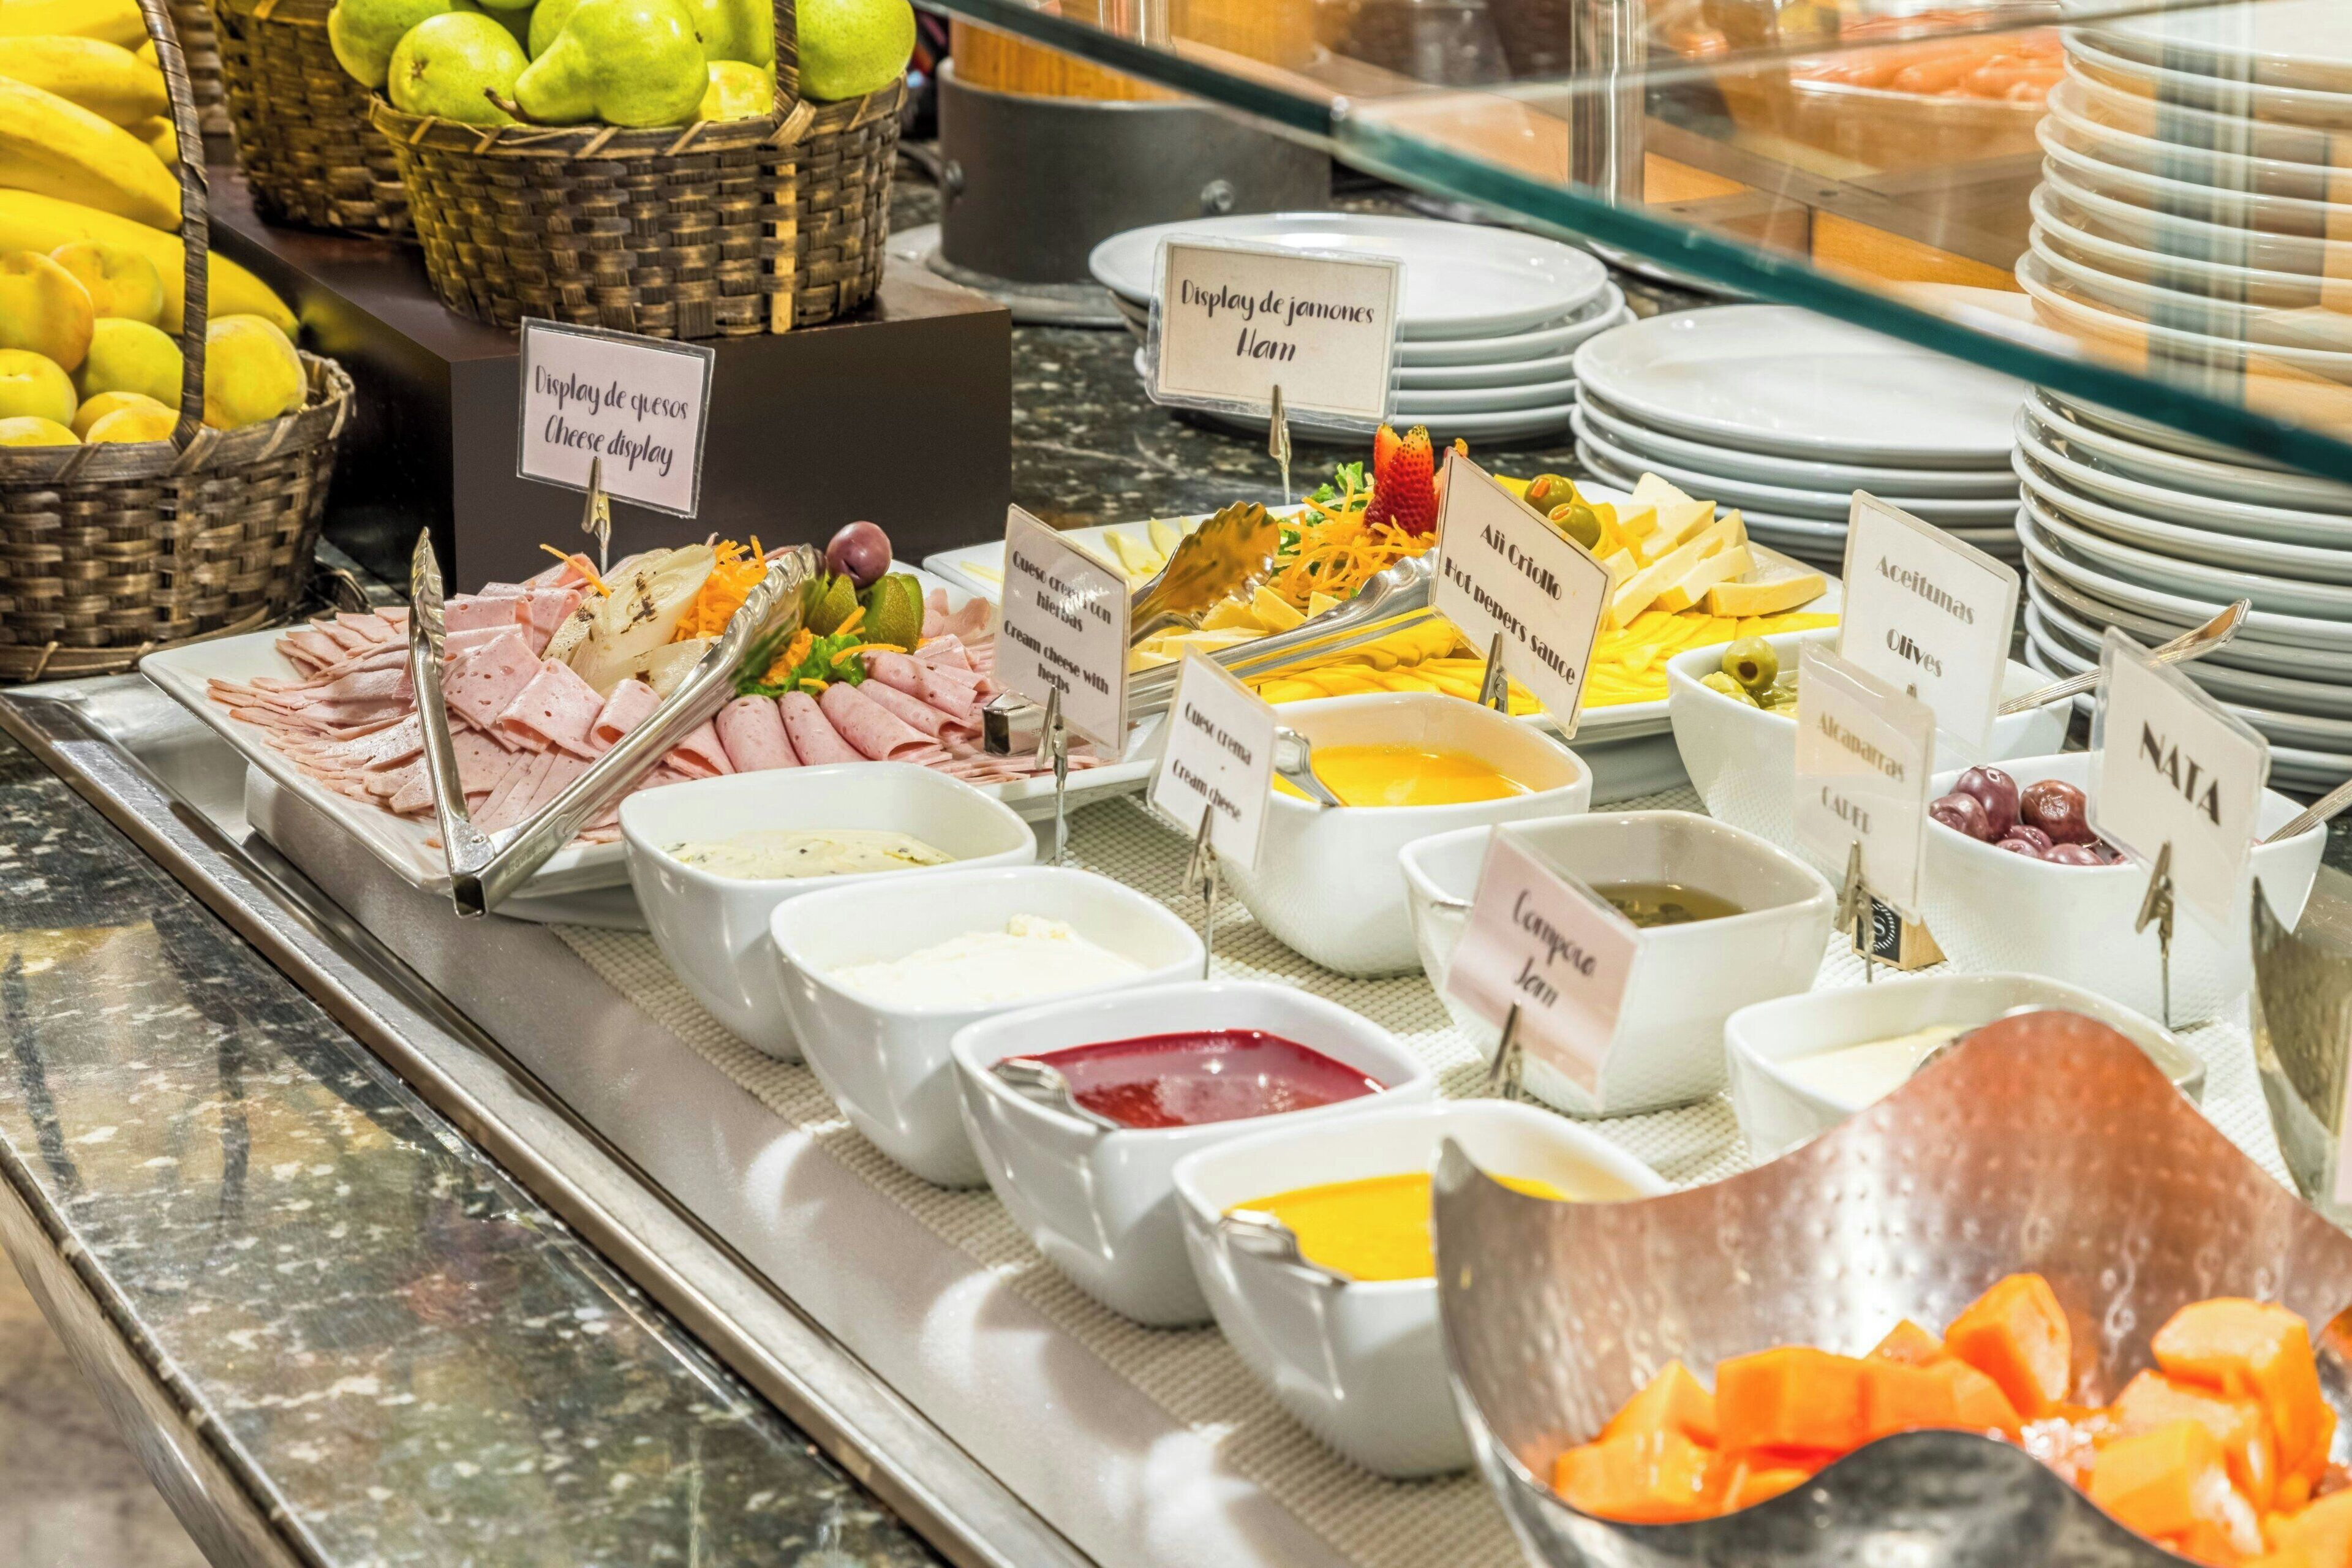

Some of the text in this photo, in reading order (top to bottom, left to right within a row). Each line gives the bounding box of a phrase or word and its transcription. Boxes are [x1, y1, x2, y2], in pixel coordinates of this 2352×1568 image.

[1182, 279, 1374, 326] Display de jamones
[1236, 327, 1296, 361] Ham
[535, 364, 688, 422] Display de quesos
[545, 414, 673, 477] Cheese display
[1012, 551, 1047, 584] Queso
[1090, 601, 1112, 625] con
[1508, 543, 1562, 601] Criollo
[1875, 554, 1976, 625] Aceitunas
[1036, 590, 1083, 633] hierbas
[1444, 556, 1575, 685] Hot pepers sauce
[1003, 619, 1109, 695] Cream cheese with
[1037, 662, 1070, 695] herbs
[1886, 628, 1942, 677] Olives
[1216, 728, 1252, 766] crema
[2139, 720, 2223, 827] NATA
[1172, 758, 1208, 797] Cream
[1514, 956, 1559, 1008] Jam
